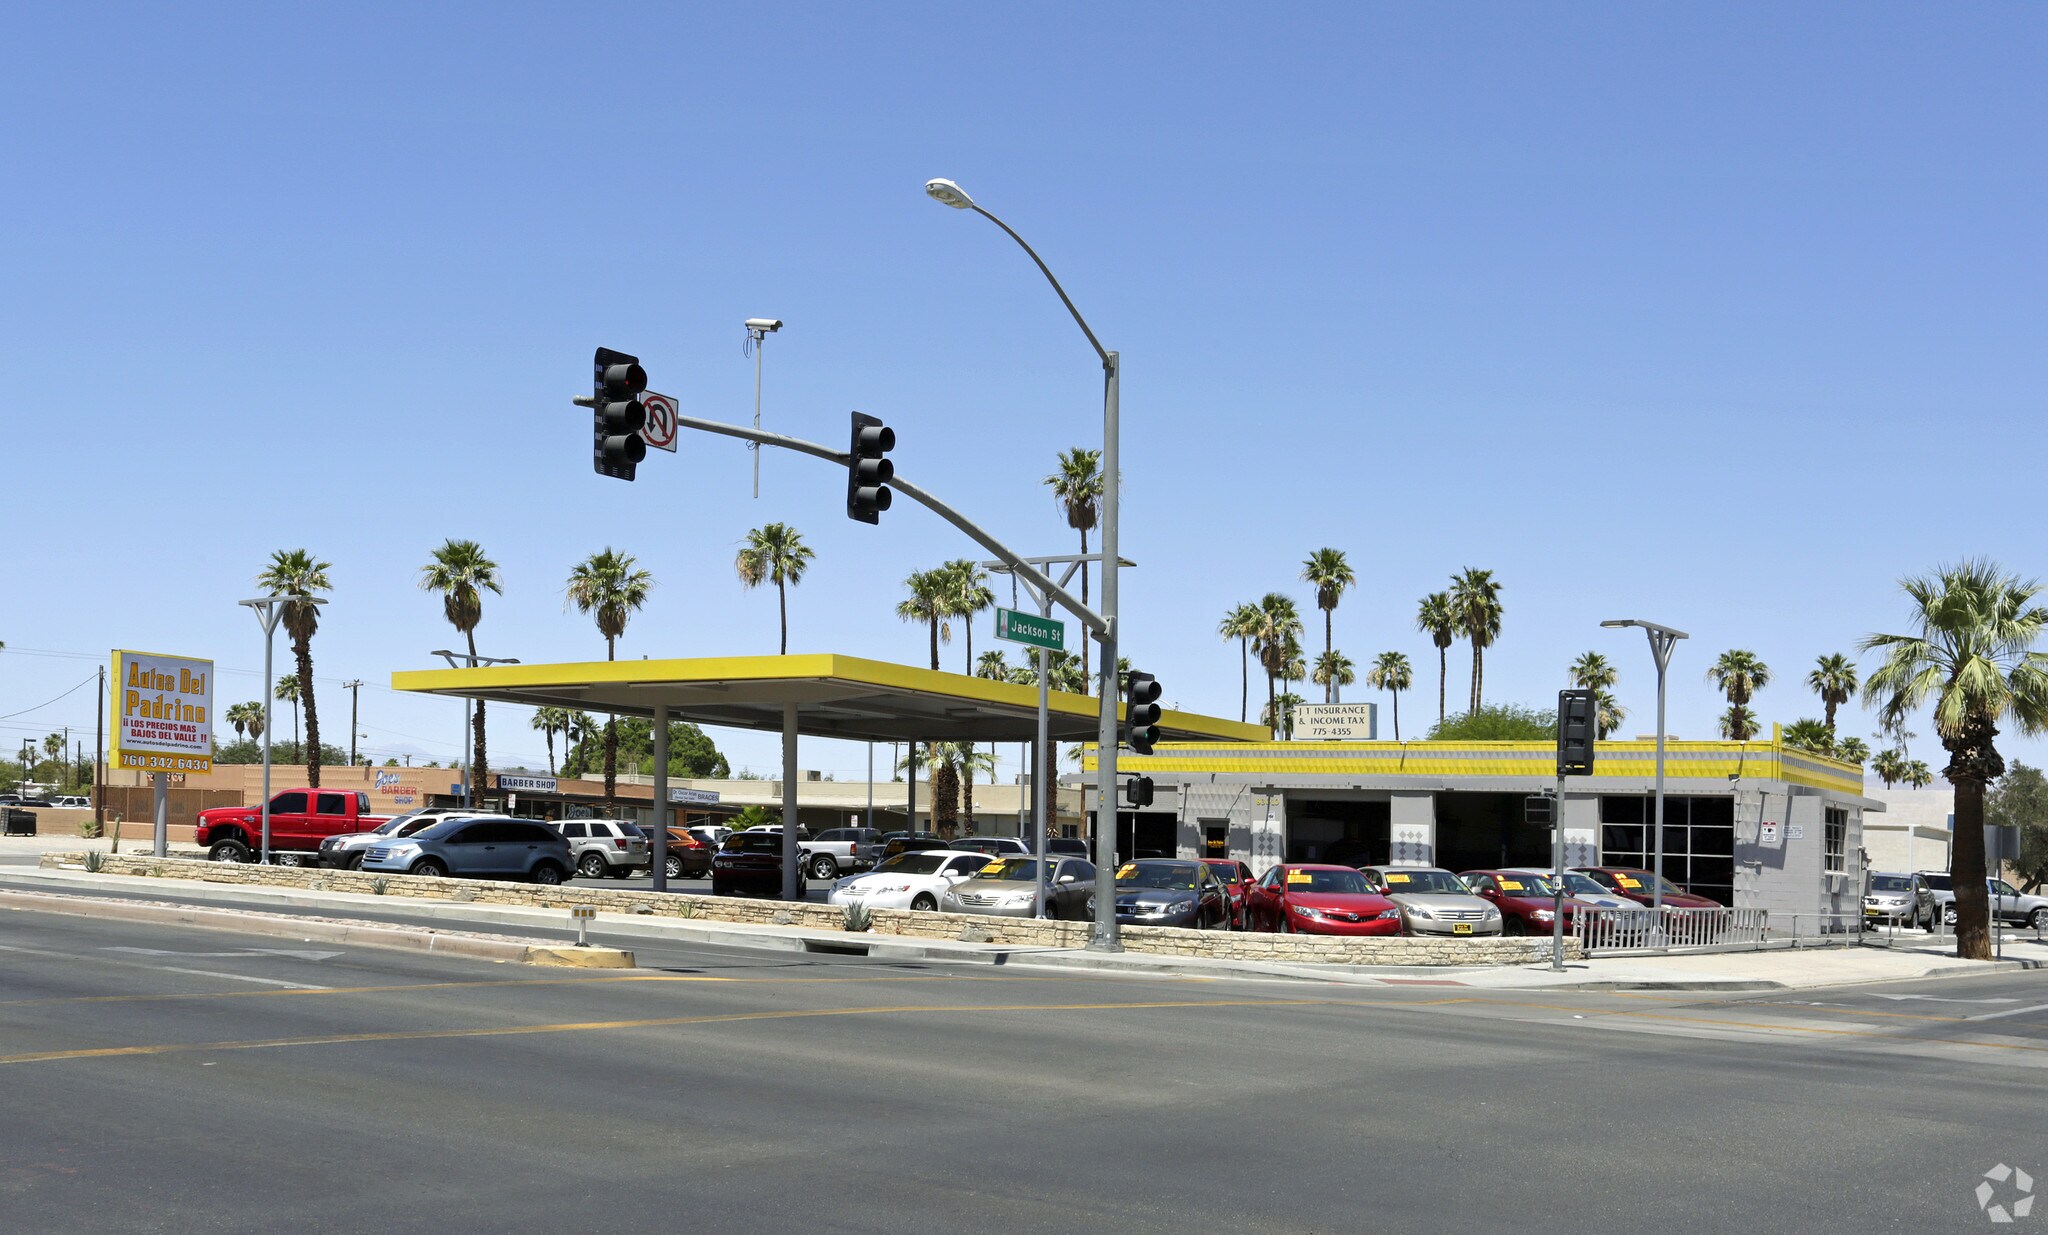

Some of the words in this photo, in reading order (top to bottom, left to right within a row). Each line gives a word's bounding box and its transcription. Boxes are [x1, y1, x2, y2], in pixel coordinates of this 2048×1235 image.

[1012, 621, 1047, 639] Jackson
[1051, 629, 1060, 641] St
[128, 662, 175, 691] Autos
[180, 668, 205, 695] Del
[125, 690, 205, 723] Padrino
[130, 719, 144, 728] LOS
[146, 721, 178, 731] PRECIOS
[180, 724, 197, 733] MAS
[1311, 717, 1345, 725] INCOME
[131, 728, 156, 739] BAJOS
[158, 731, 172, 740] DEL
[174, 733, 197, 742] VALLE
[126, 739, 202, 749] www.autosdelpadrino.com
[122, 754, 208, 770] 760.342.6434
[502, 778, 534, 788] BARBER
[536, 780, 556, 789] SHOP
[381, 786, 417, 796] BARBER
[395, 796, 414, 804] SHOP
